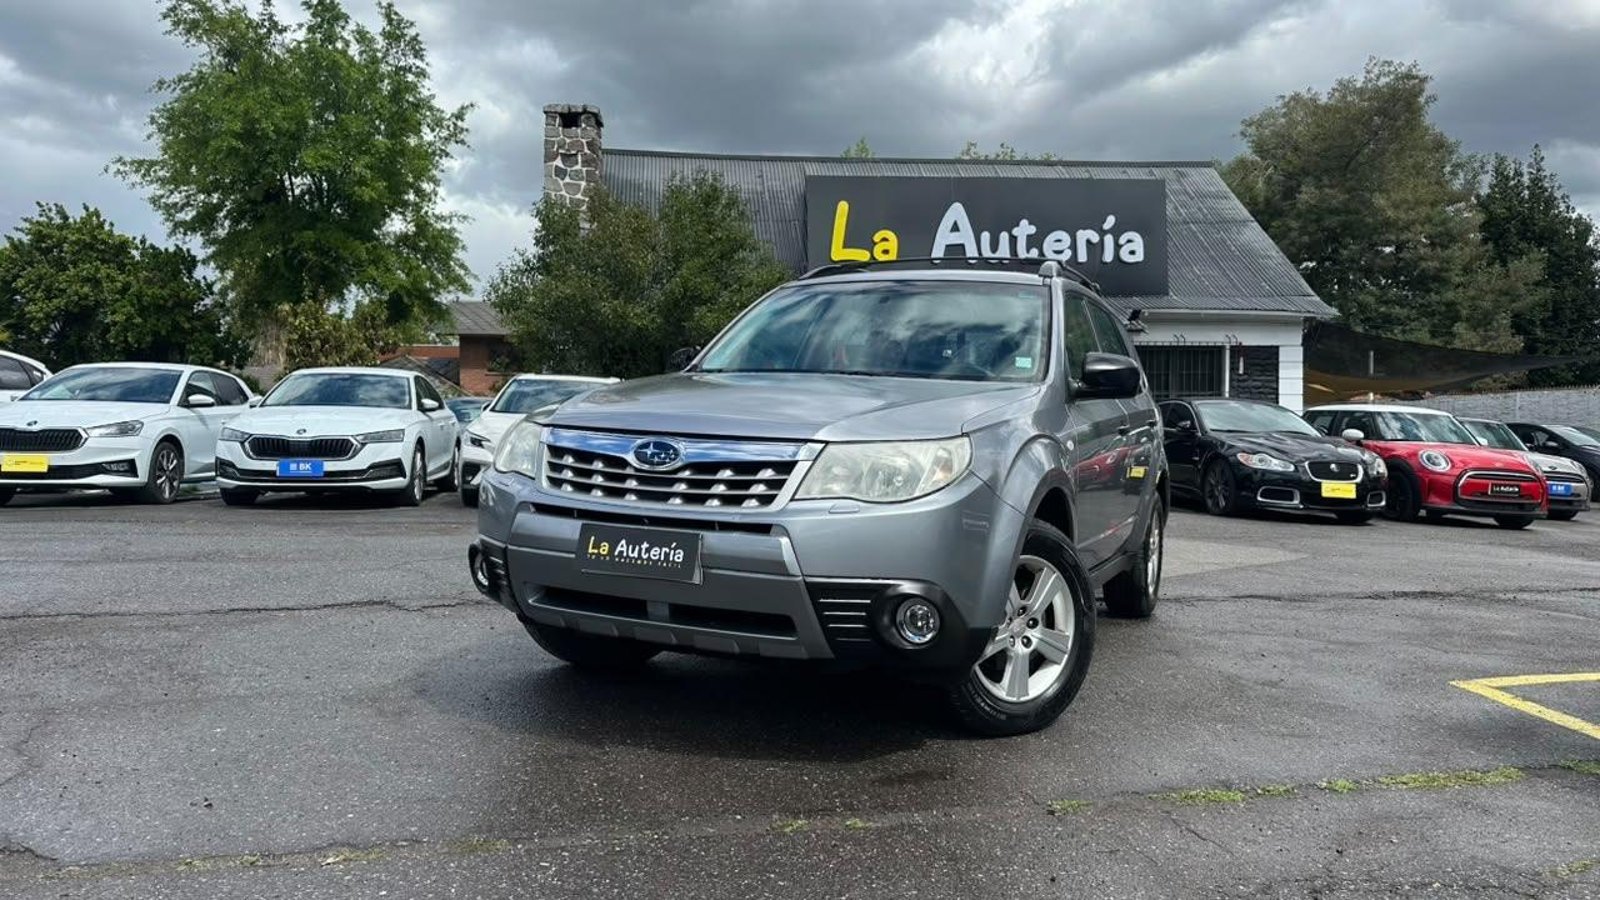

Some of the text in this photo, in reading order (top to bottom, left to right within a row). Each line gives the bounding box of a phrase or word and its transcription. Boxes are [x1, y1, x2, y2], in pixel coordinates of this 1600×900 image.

[830, 200, 1145, 264] La Autería
[587, 535, 610, 555] La
[614, 538, 685, 562] Autería
